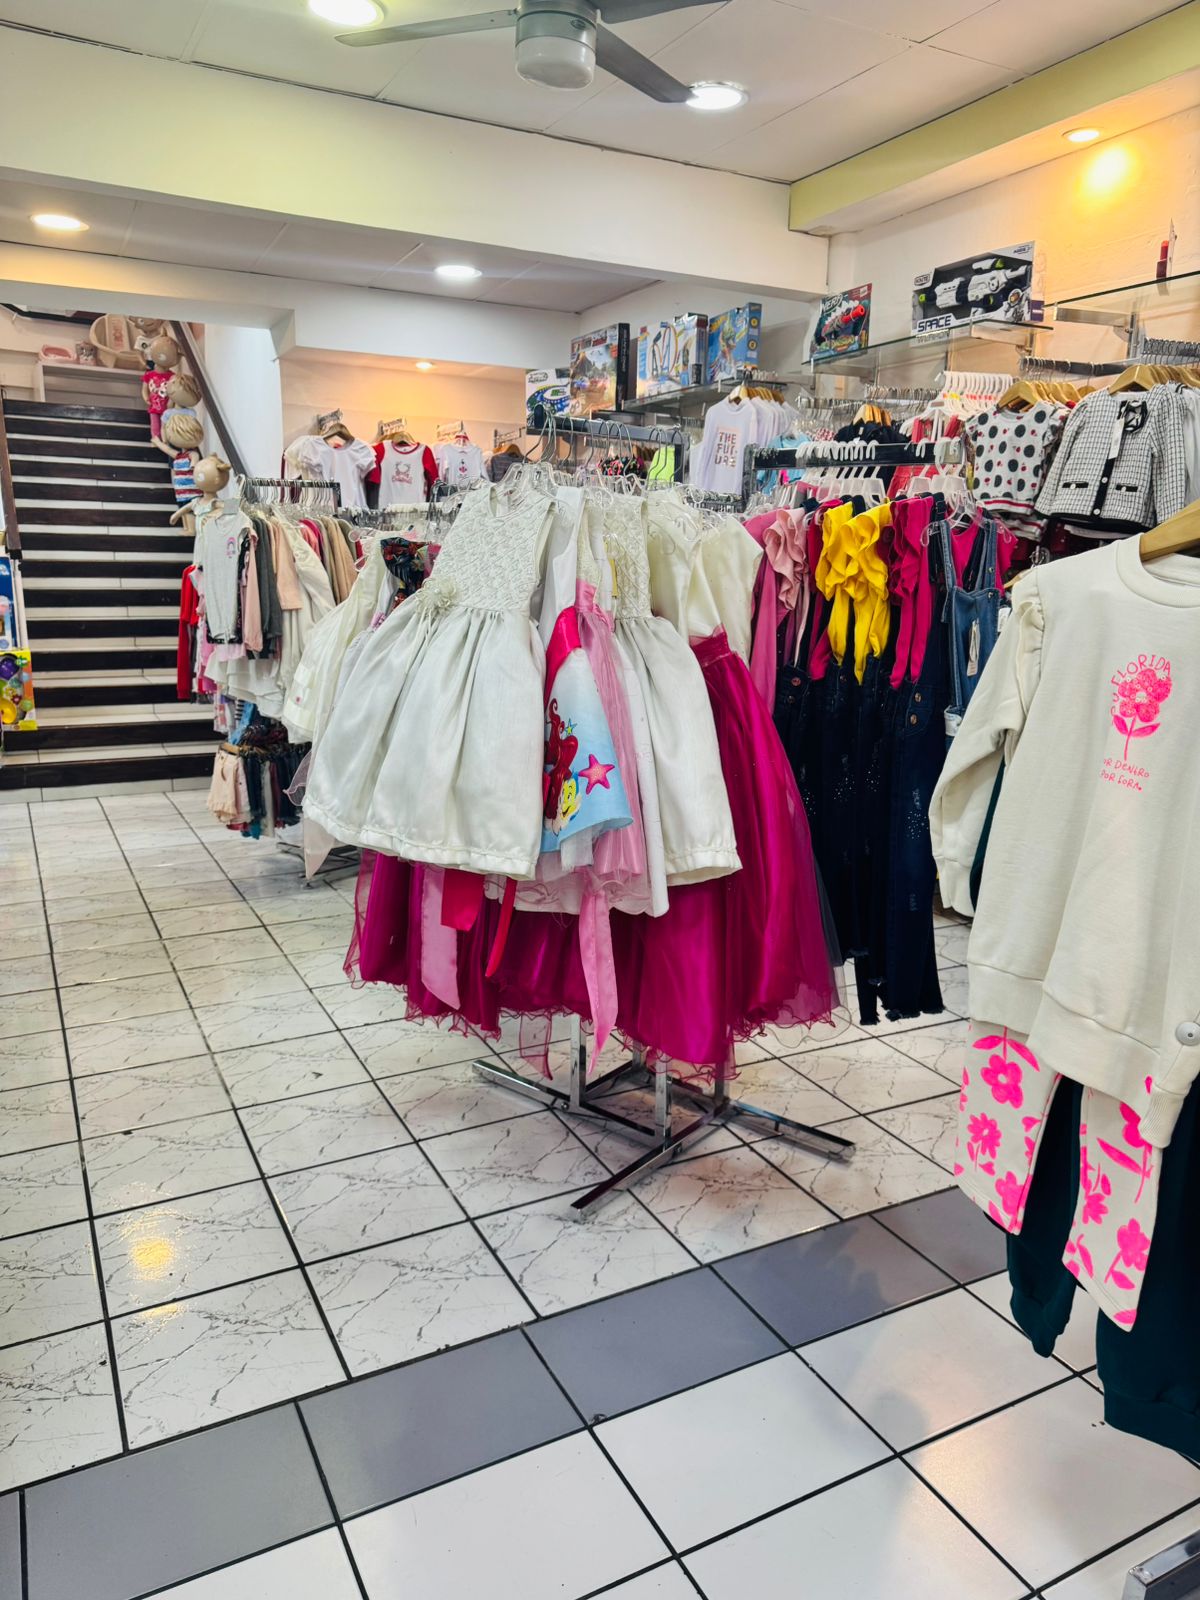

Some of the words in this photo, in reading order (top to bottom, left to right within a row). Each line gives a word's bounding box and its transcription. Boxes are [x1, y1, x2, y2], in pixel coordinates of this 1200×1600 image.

[917, 314, 952, 332] SPACE
[719, 432, 737, 444] THE
[1110, 654, 1171, 686] FLORIDA
